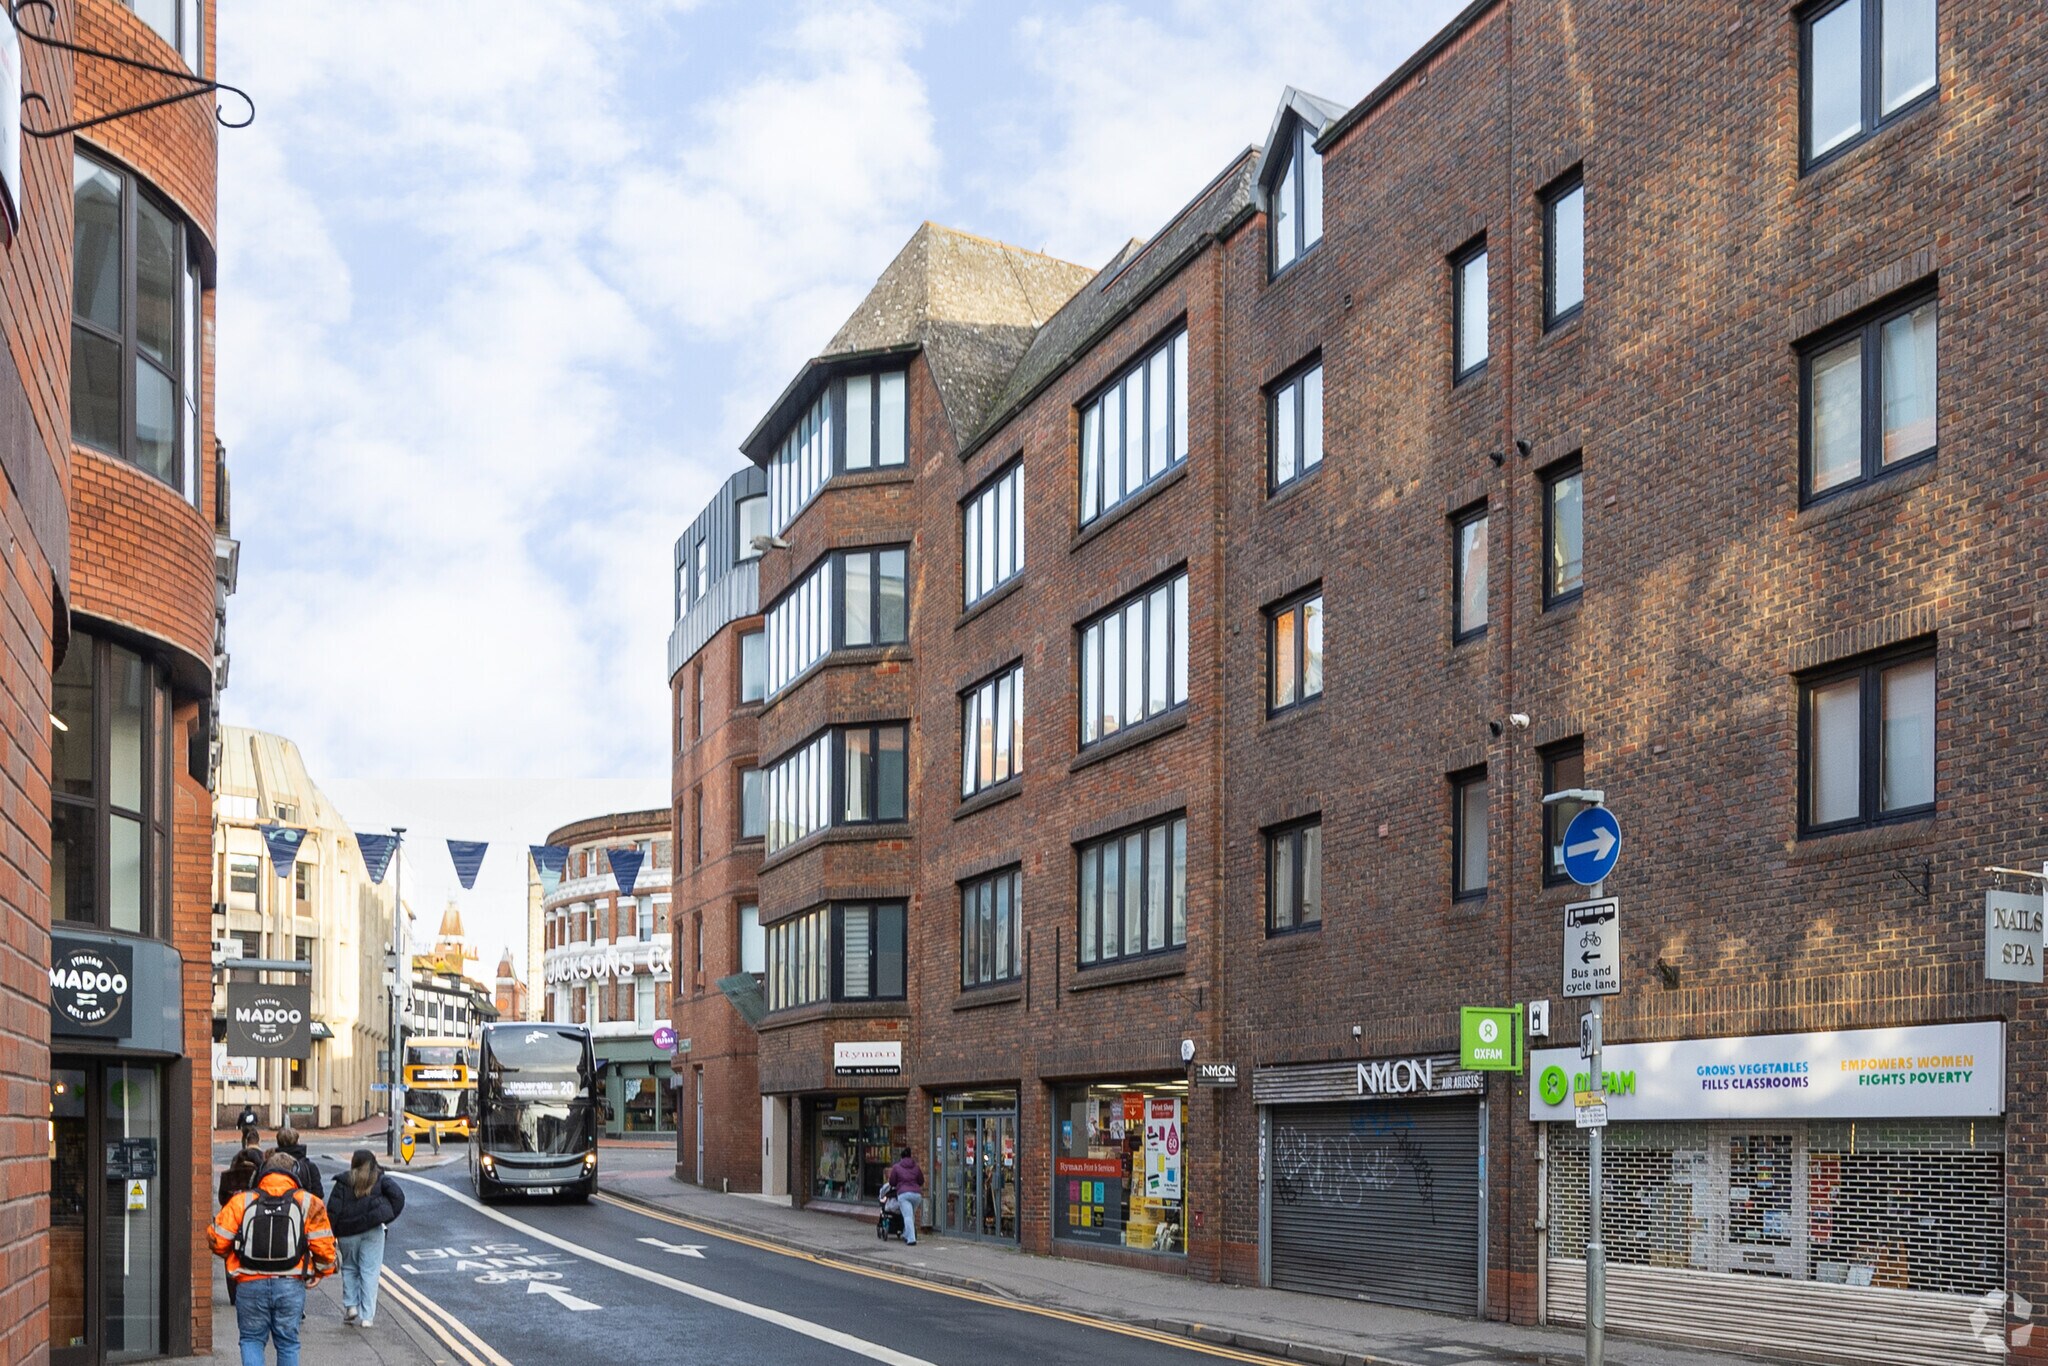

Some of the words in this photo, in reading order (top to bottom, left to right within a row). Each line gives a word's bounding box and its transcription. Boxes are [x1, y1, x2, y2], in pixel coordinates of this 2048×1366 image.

[1994, 908, 2043, 933] NAILS
[2002, 942, 2035, 966] SPA
[71, 955, 103, 969] ITALIAN
[547, 950, 635, 984] JACKSONS
[1571, 968, 1589, 979] Bus
[1593, 965, 1611, 977] and
[48, 966, 128, 994] MADOO
[1566, 980, 1592, 994] cycle
[1595, 979, 1617, 990] lane
[254, 998, 281, 1007] ITALIAN
[67, 1004, 84, 1019] DELI
[236, 1007, 302, 1024] MADOO
[839, 1050, 897, 1060] Ryman
[1474, 1048, 1503, 1060] OXFAM
[1202, 1064, 1236, 1077] NYLON
[1696, 1064, 1736, 1076] GROWS
[1738, 1061, 1809, 1075] VEGETABLES
[1840, 1057, 1914, 1071] EMPOWERS
[1917, 1055, 1974, 1069] WOMEN
[1357, 1058, 1433, 1095] NYLON
[1453, 1075, 1480, 1089] ARTISTS
[1702, 1079, 1729, 1090] FILLS
[1732, 1076, 1809, 1089] CLASSROOMS
[1858, 1073, 1906, 1086] FIGHTS
[1910, 1070, 1973, 1085] POVERTY
[560, 1081, 574, 1095] 20
[1168, 1138, 1177, 1149] 60
[1060, 1162, 1083, 1172] Ryman
[406, 1244, 528, 1261] BUS
[401, 1253, 578, 1275] LANE
